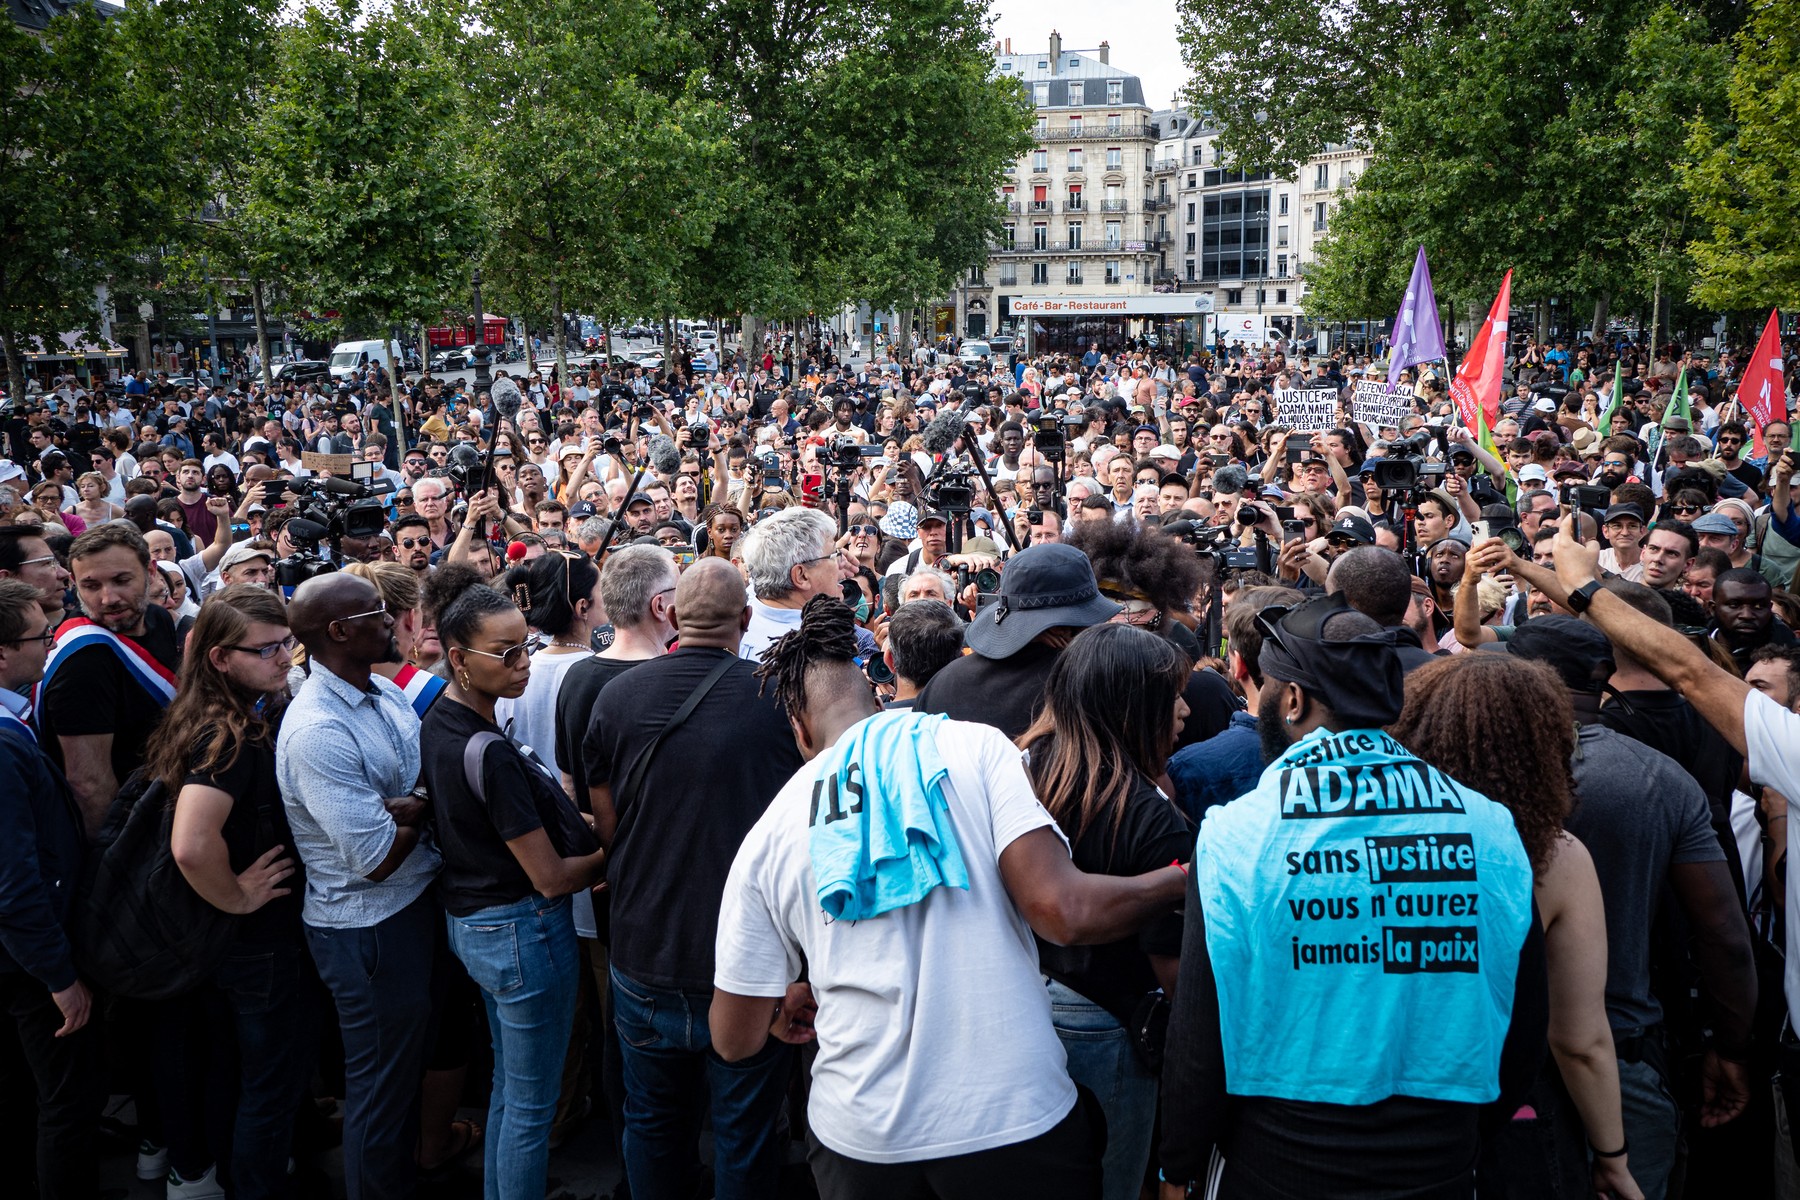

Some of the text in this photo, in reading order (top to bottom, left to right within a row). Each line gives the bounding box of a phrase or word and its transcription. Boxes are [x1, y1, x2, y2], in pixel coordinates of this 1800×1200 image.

[1357, 381, 1412, 397] DEFENDNS LA
[1278, 391, 1337, 403] JUSTICE POUR
[1278, 404, 1333, 415] ADAMA NAHEL
[1354, 403, 1362, 412] DE
[1326, 415, 1335, 423] ET
[1354, 412, 1361, 421] ET
[1342, 518, 1353, 528] LA
[1282, 763, 1463, 814] ADAMA
[1286, 836, 1475, 882] sans justice
[1288, 886, 1478, 920] vous n'aurez
[1292, 929, 1477, 970] jamais la paix
